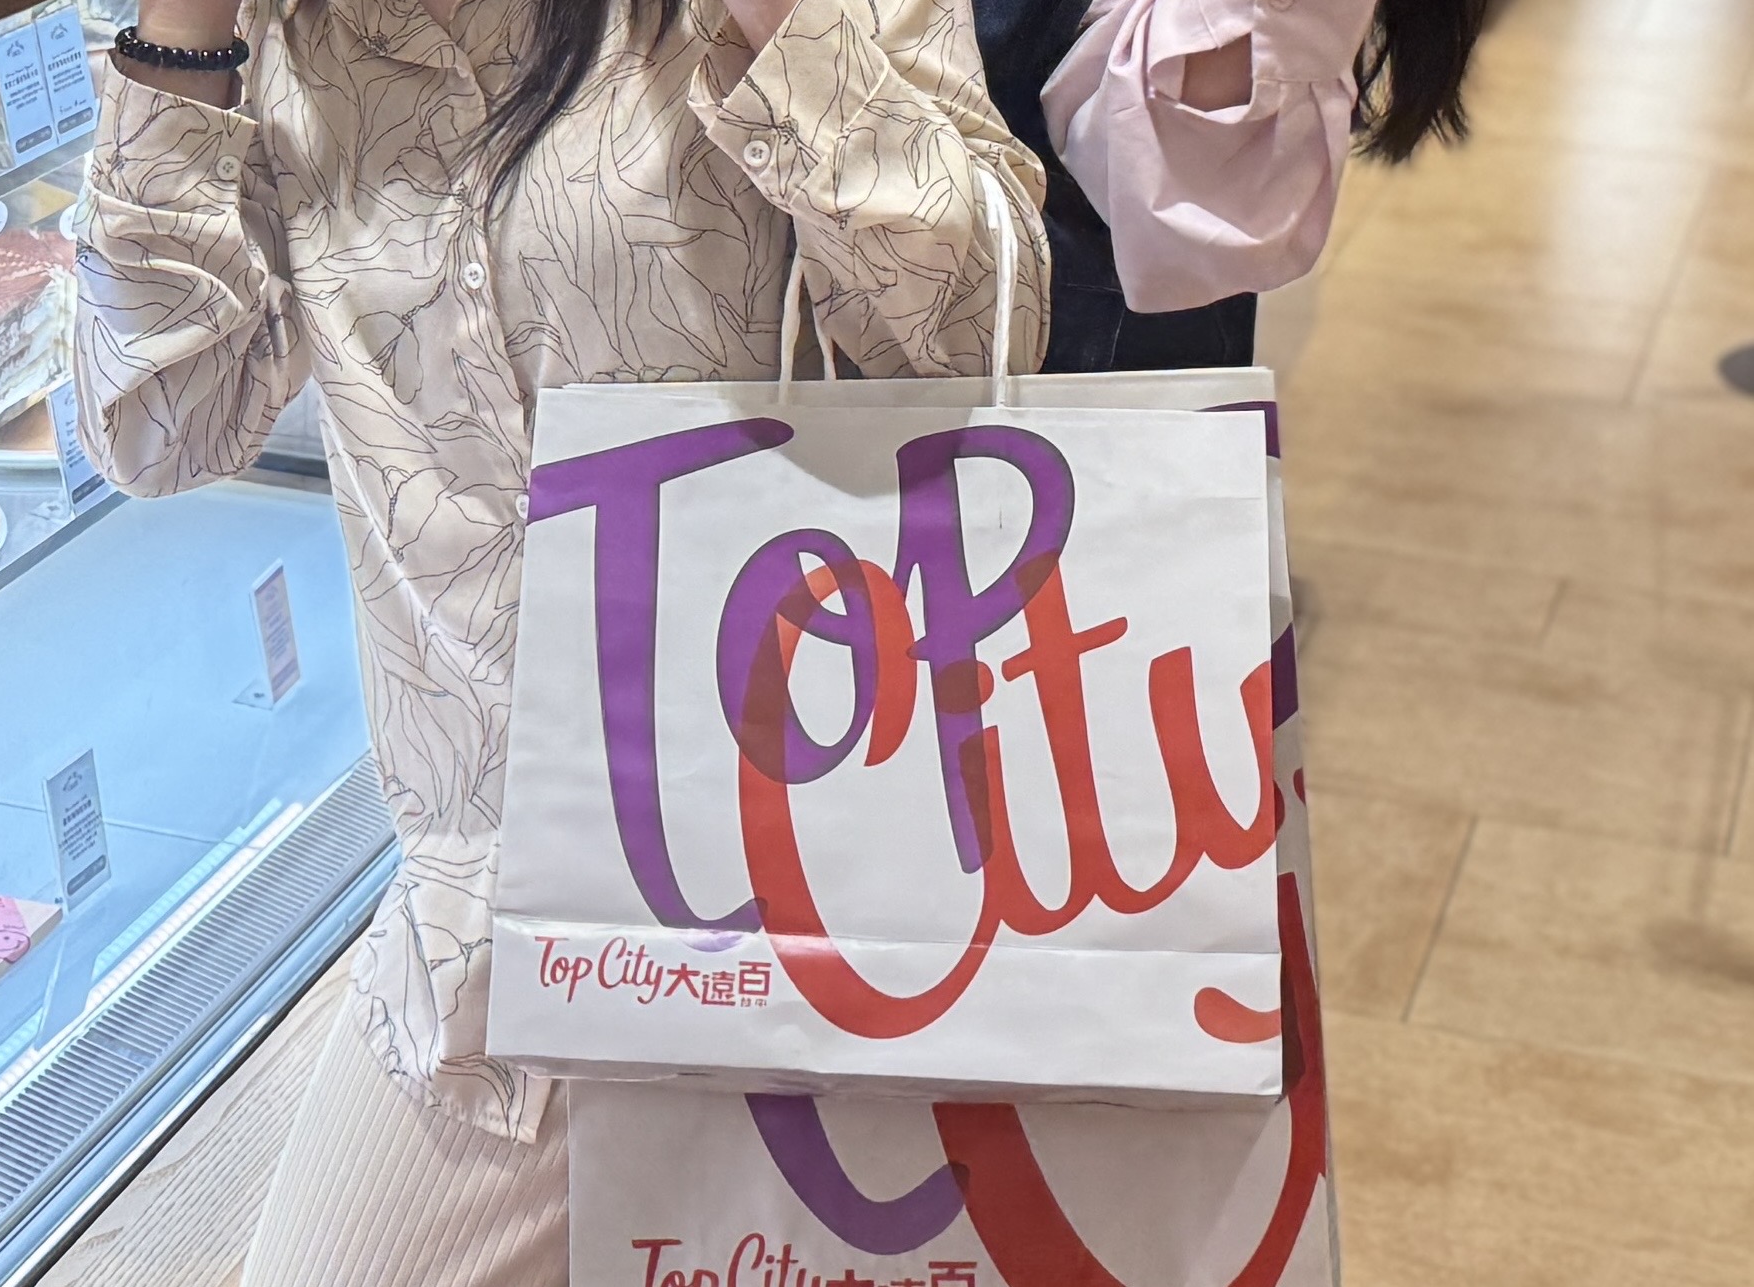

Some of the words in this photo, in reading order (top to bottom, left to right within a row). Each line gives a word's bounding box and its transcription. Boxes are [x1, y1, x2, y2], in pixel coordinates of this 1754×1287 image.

[534, 935, 594, 1004] Top
[597, 936, 664, 1005] City
[663, 960, 773, 1007] 大遠百
